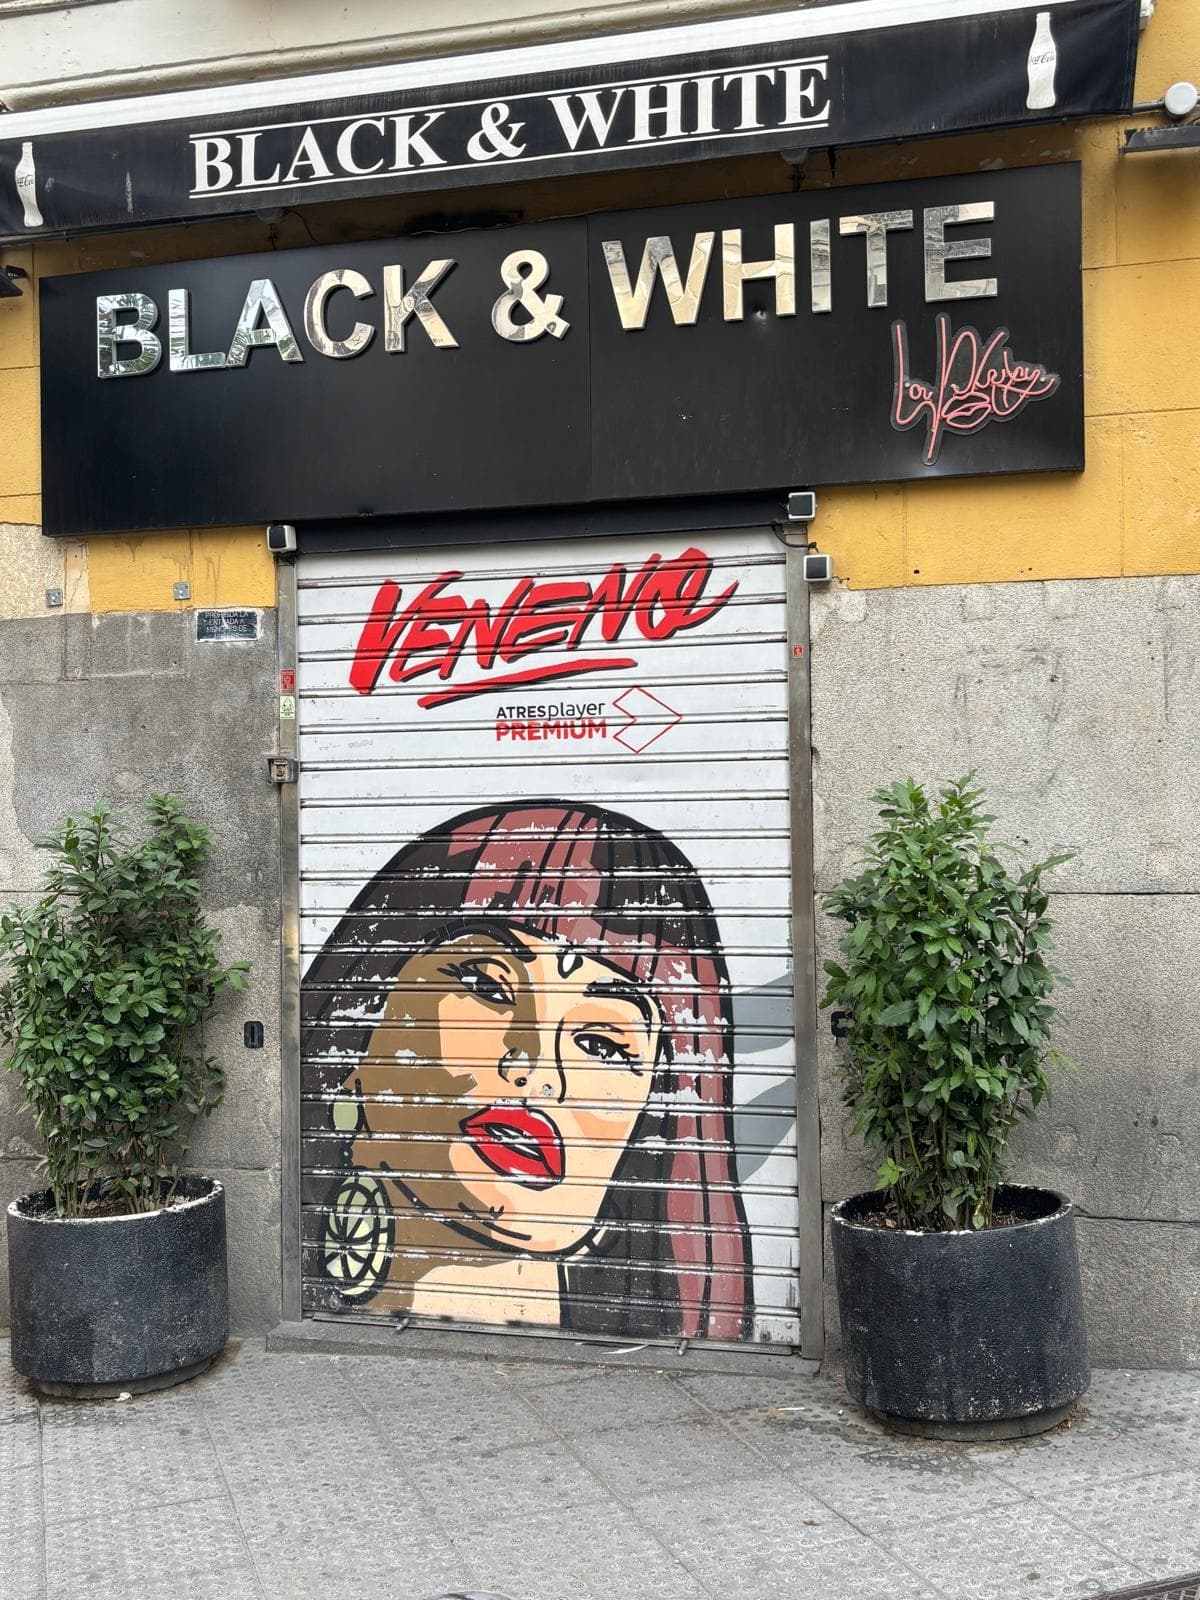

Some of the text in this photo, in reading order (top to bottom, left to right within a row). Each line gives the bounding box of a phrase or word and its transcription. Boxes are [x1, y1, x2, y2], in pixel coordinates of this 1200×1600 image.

[190, 62, 831, 193] BLACK & WHITE
[96, 201, 998, 378] BLACK & WHITE
[348, 547, 741, 695] VENENO
[496, 702, 606, 721] ATRESplayer
[496, 719, 607, 741] PREMIUM
